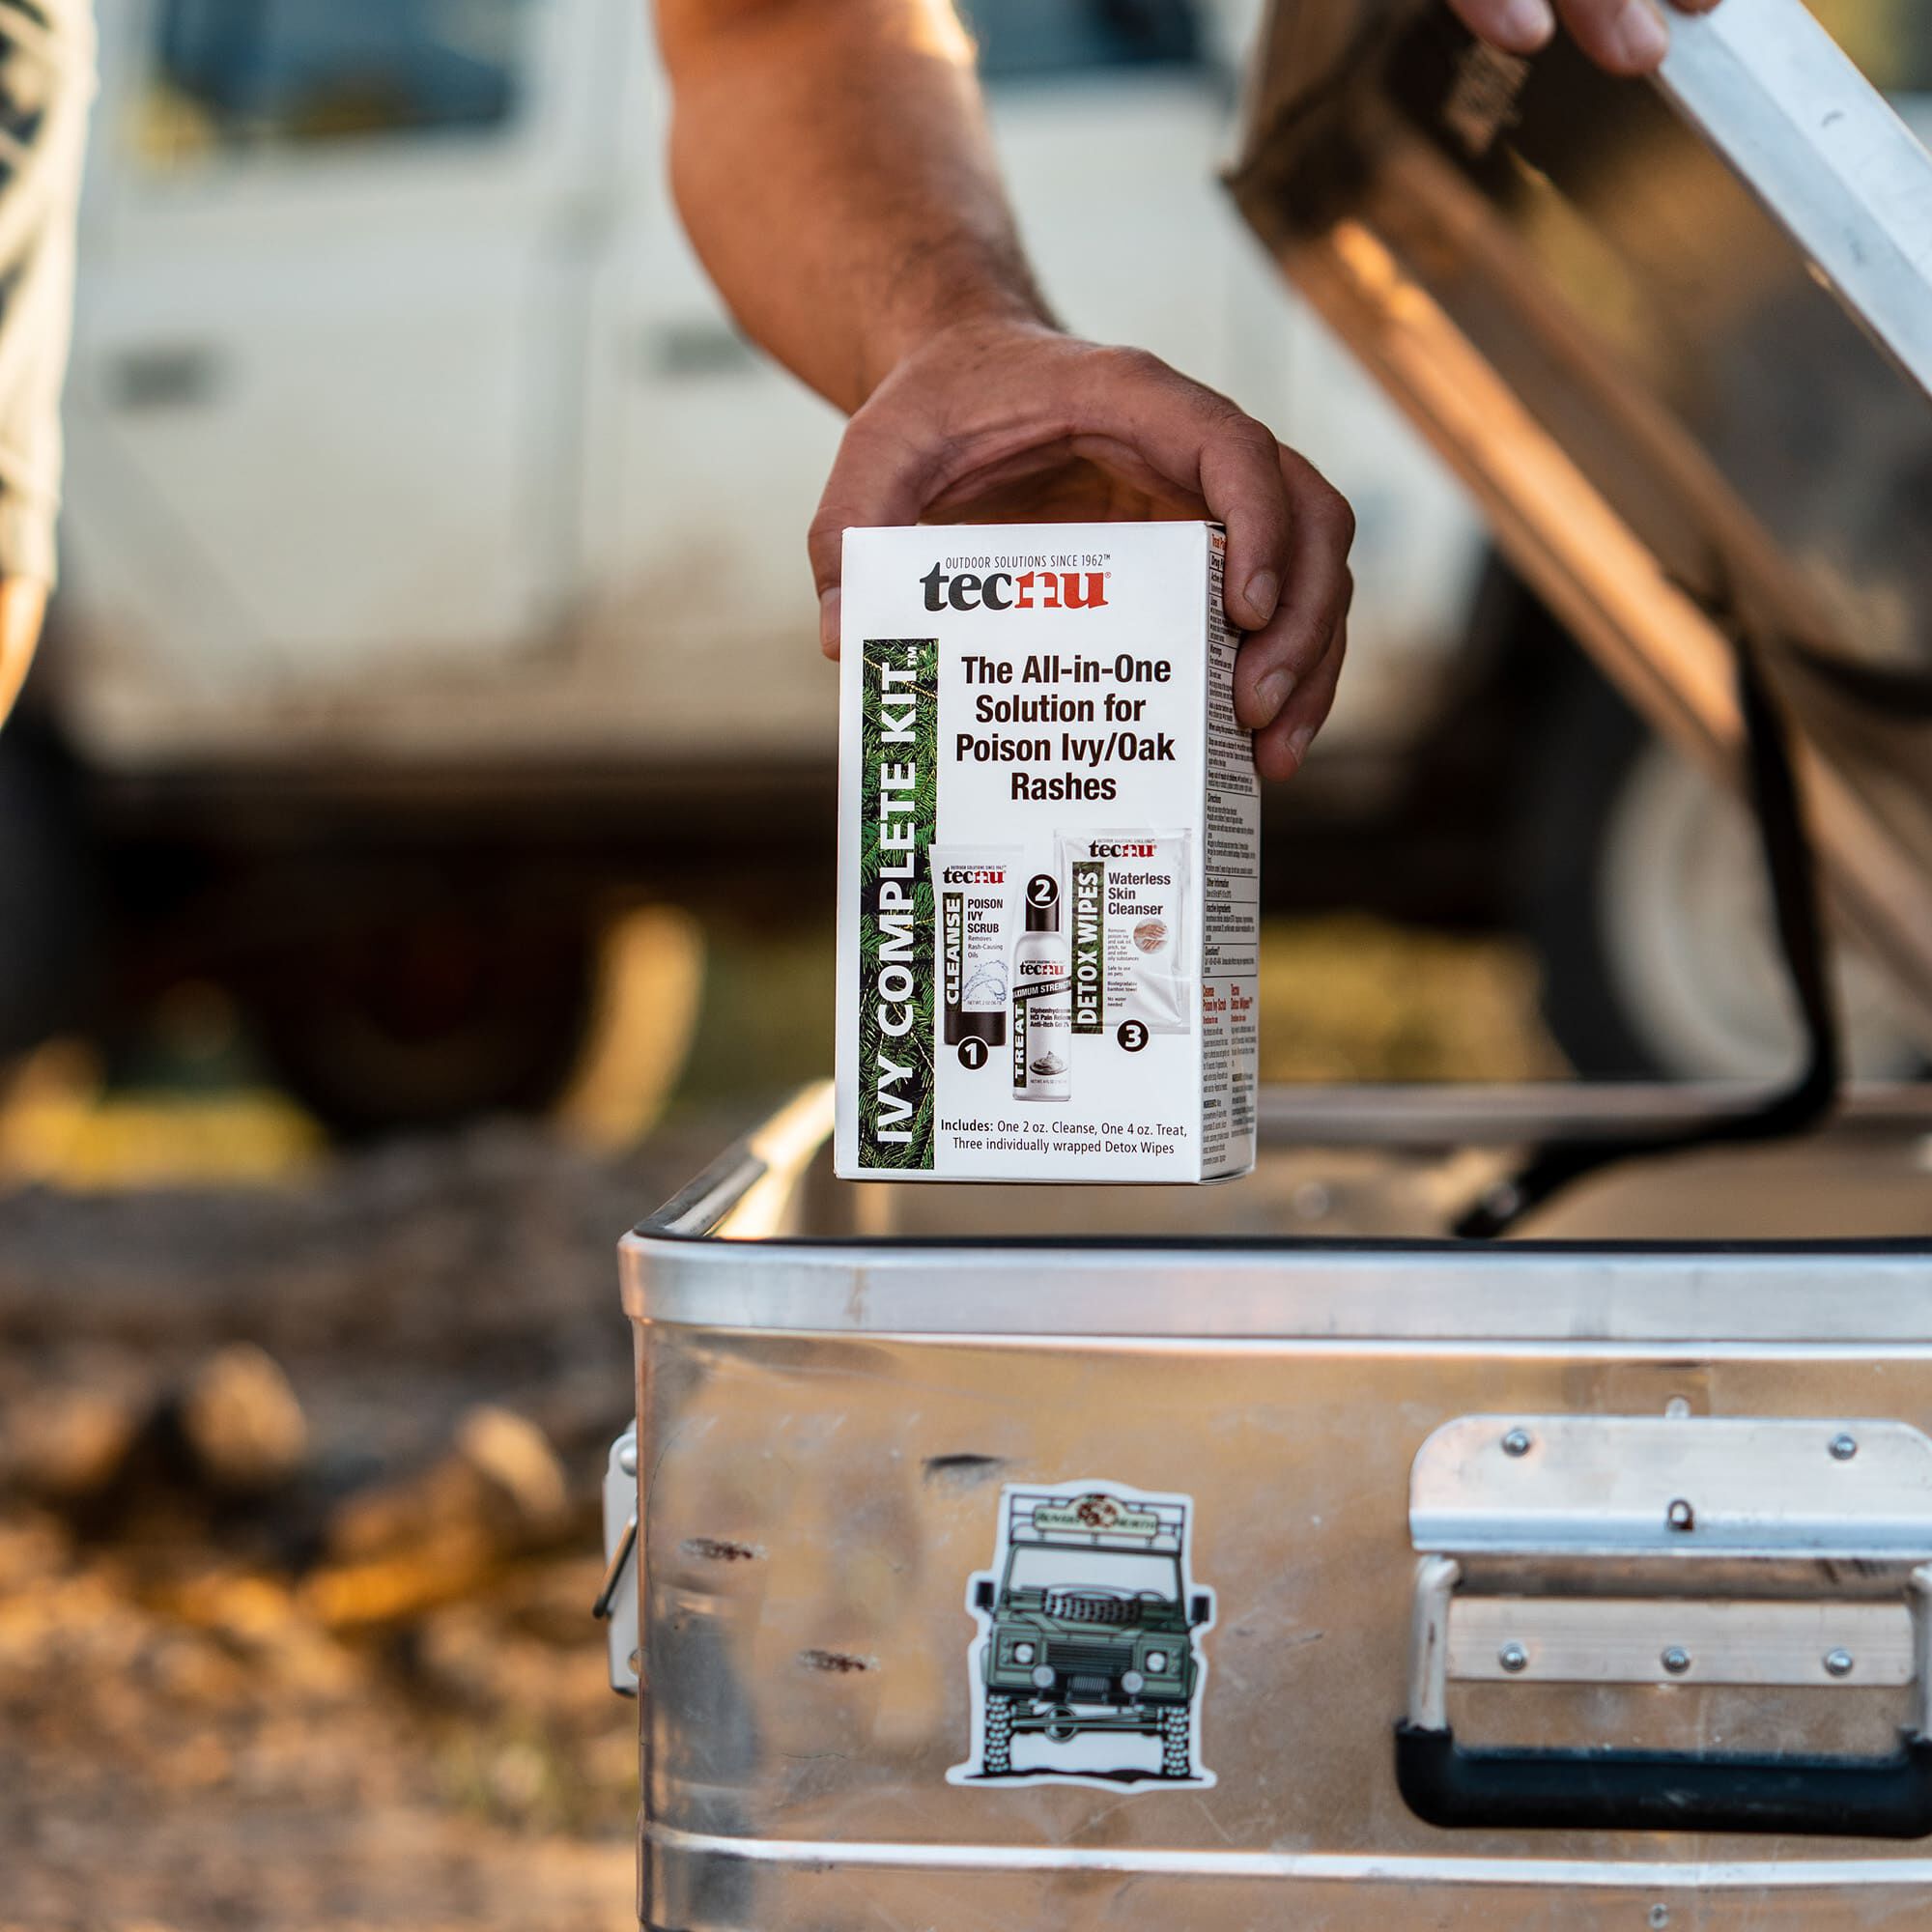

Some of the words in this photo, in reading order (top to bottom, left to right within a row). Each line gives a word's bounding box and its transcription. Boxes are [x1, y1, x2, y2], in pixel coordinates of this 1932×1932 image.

[946, 556, 991, 569] OUTDOOR
[994, 555, 1047, 568] SOLUTIONS
[1051, 554, 1078, 567] SINCE
[961, 656, 1012, 684] The
[1022, 654, 1171, 683] All-in-One
[976, 695, 1094, 723] Solution
[1104, 694, 1147, 722] for
[955, 734, 1051, 761] Poison
[1062, 731, 1176, 767] Ivy/Oak
[1010, 773, 1117, 800] Rashes
[1108, 872, 1171, 885] Waterless
[878, 762, 916, 1037] COMPLETE
[1035, 879, 1051, 902] 2
[1108, 887, 1136, 900] Skin
[968, 898, 1003, 909] POISON
[1078, 872, 1098, 943] WIPES
[1108, 902, 1163, 915] Cleanser
[967, 911, 983, 921] IVY
[968, 923, 999, 933] SCRUB
[946, 899, 961, 1004] CLEANSE
[1077, 950, 1098, 1024] DETOX
[1015, 1005, 1024, 1079] TREAT
[1125, 1026, 1141, 1048] 3
[964, 1043, 978, 1065] 1
[877, 1055, 914, 1143] IVY
[941, 1119, 993, 1132] Includes:
[997, 1120, 1019, 1132] One
[1023, 1121, 1029, 1132] 2
[1033, 1124, 1048, 1133] oz.
[1052, 1122, 1097, 1136] Cleanse,
[1101, 1123, 1123, 1135] One
[1127, 1123, 1134, 1135] 4
[1137, 1126, 1153, 1136] oz.
[1155, 1123, 1187, 1138] Treat,
[952, 1137, 982, 1150] Three
[986, 1138, 1049, 1153] individually
[1053, 1140, 1101, 1154] wrapped
[1105, 1141, 1137, 1153] Detox
[1141, 1142, 1175, 1155] Wipes
